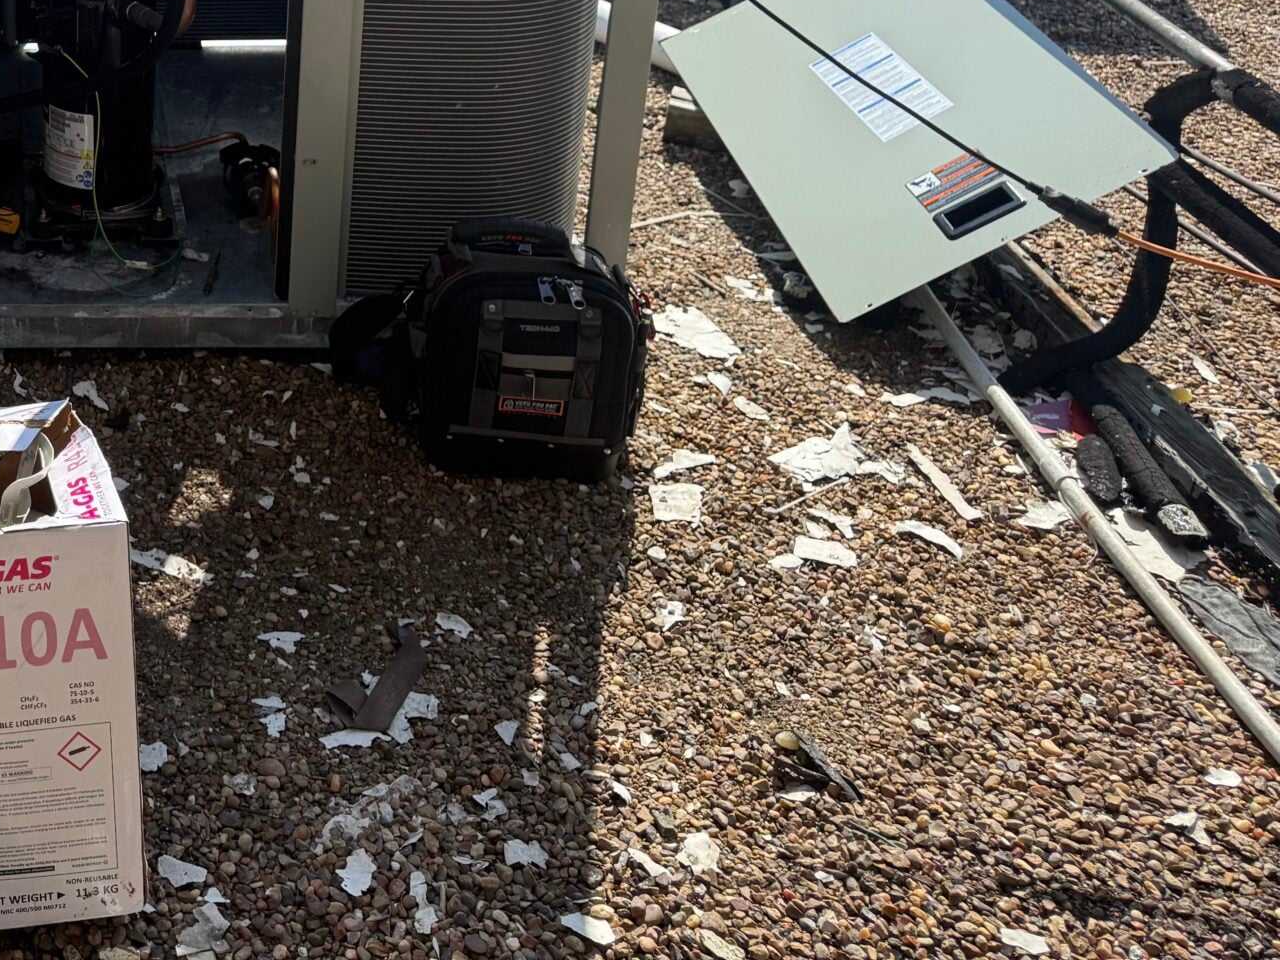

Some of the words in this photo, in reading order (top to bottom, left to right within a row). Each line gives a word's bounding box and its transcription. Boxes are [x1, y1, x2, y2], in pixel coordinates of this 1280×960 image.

[67, 476, 102, 520] A-GAS
[5, 583, 25, 595] WE
[27, 581, 52, 593] CAN
[70, 689, 95, 697] 75-10-5
[70, 696, 100, 705] 354-33-6
[15, 716, 58, 728] LIQUEFIED
[59, 714, 76, 723] GAS
[65, 874, 119, 885] NON-REUSABLE
[9, 892, 54, 904] WEIGHT
[103, 883, 119, 895] KG
